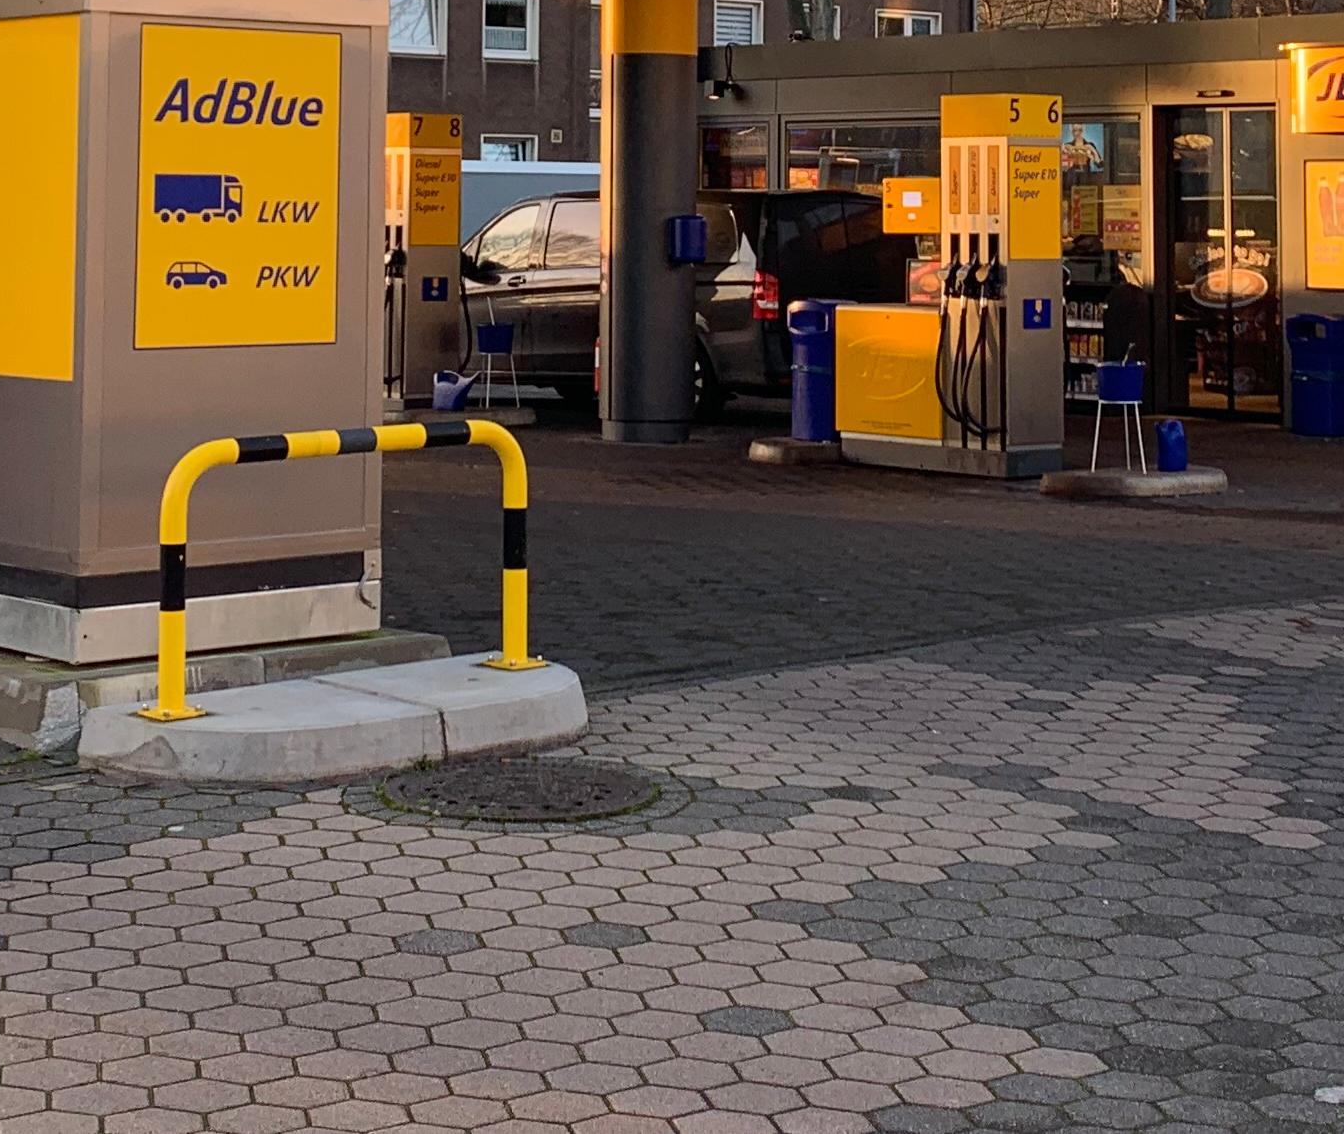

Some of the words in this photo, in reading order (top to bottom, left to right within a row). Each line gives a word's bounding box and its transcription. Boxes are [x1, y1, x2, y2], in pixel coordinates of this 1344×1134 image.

[154, 78, 324, 127] AdBlue
[1009, 98, 1020, 123] 5
[1047, 100, 1059, 123] 6
[413, 116, 424, 137] 7
[449, 118, 460, 137] 8
[415, 158, 442, 169] Diesel
[1013, 150, 1042, 163] Diesel
[415, 172, 439, 184] Super
[1013, 168, 1040, 183] Super
[415, 187, 439, 199] Super
[1013, 186, 1040, 202] Super
[256, 201, 320, 224] LKW
[256, 266, 320, 288] PKW
